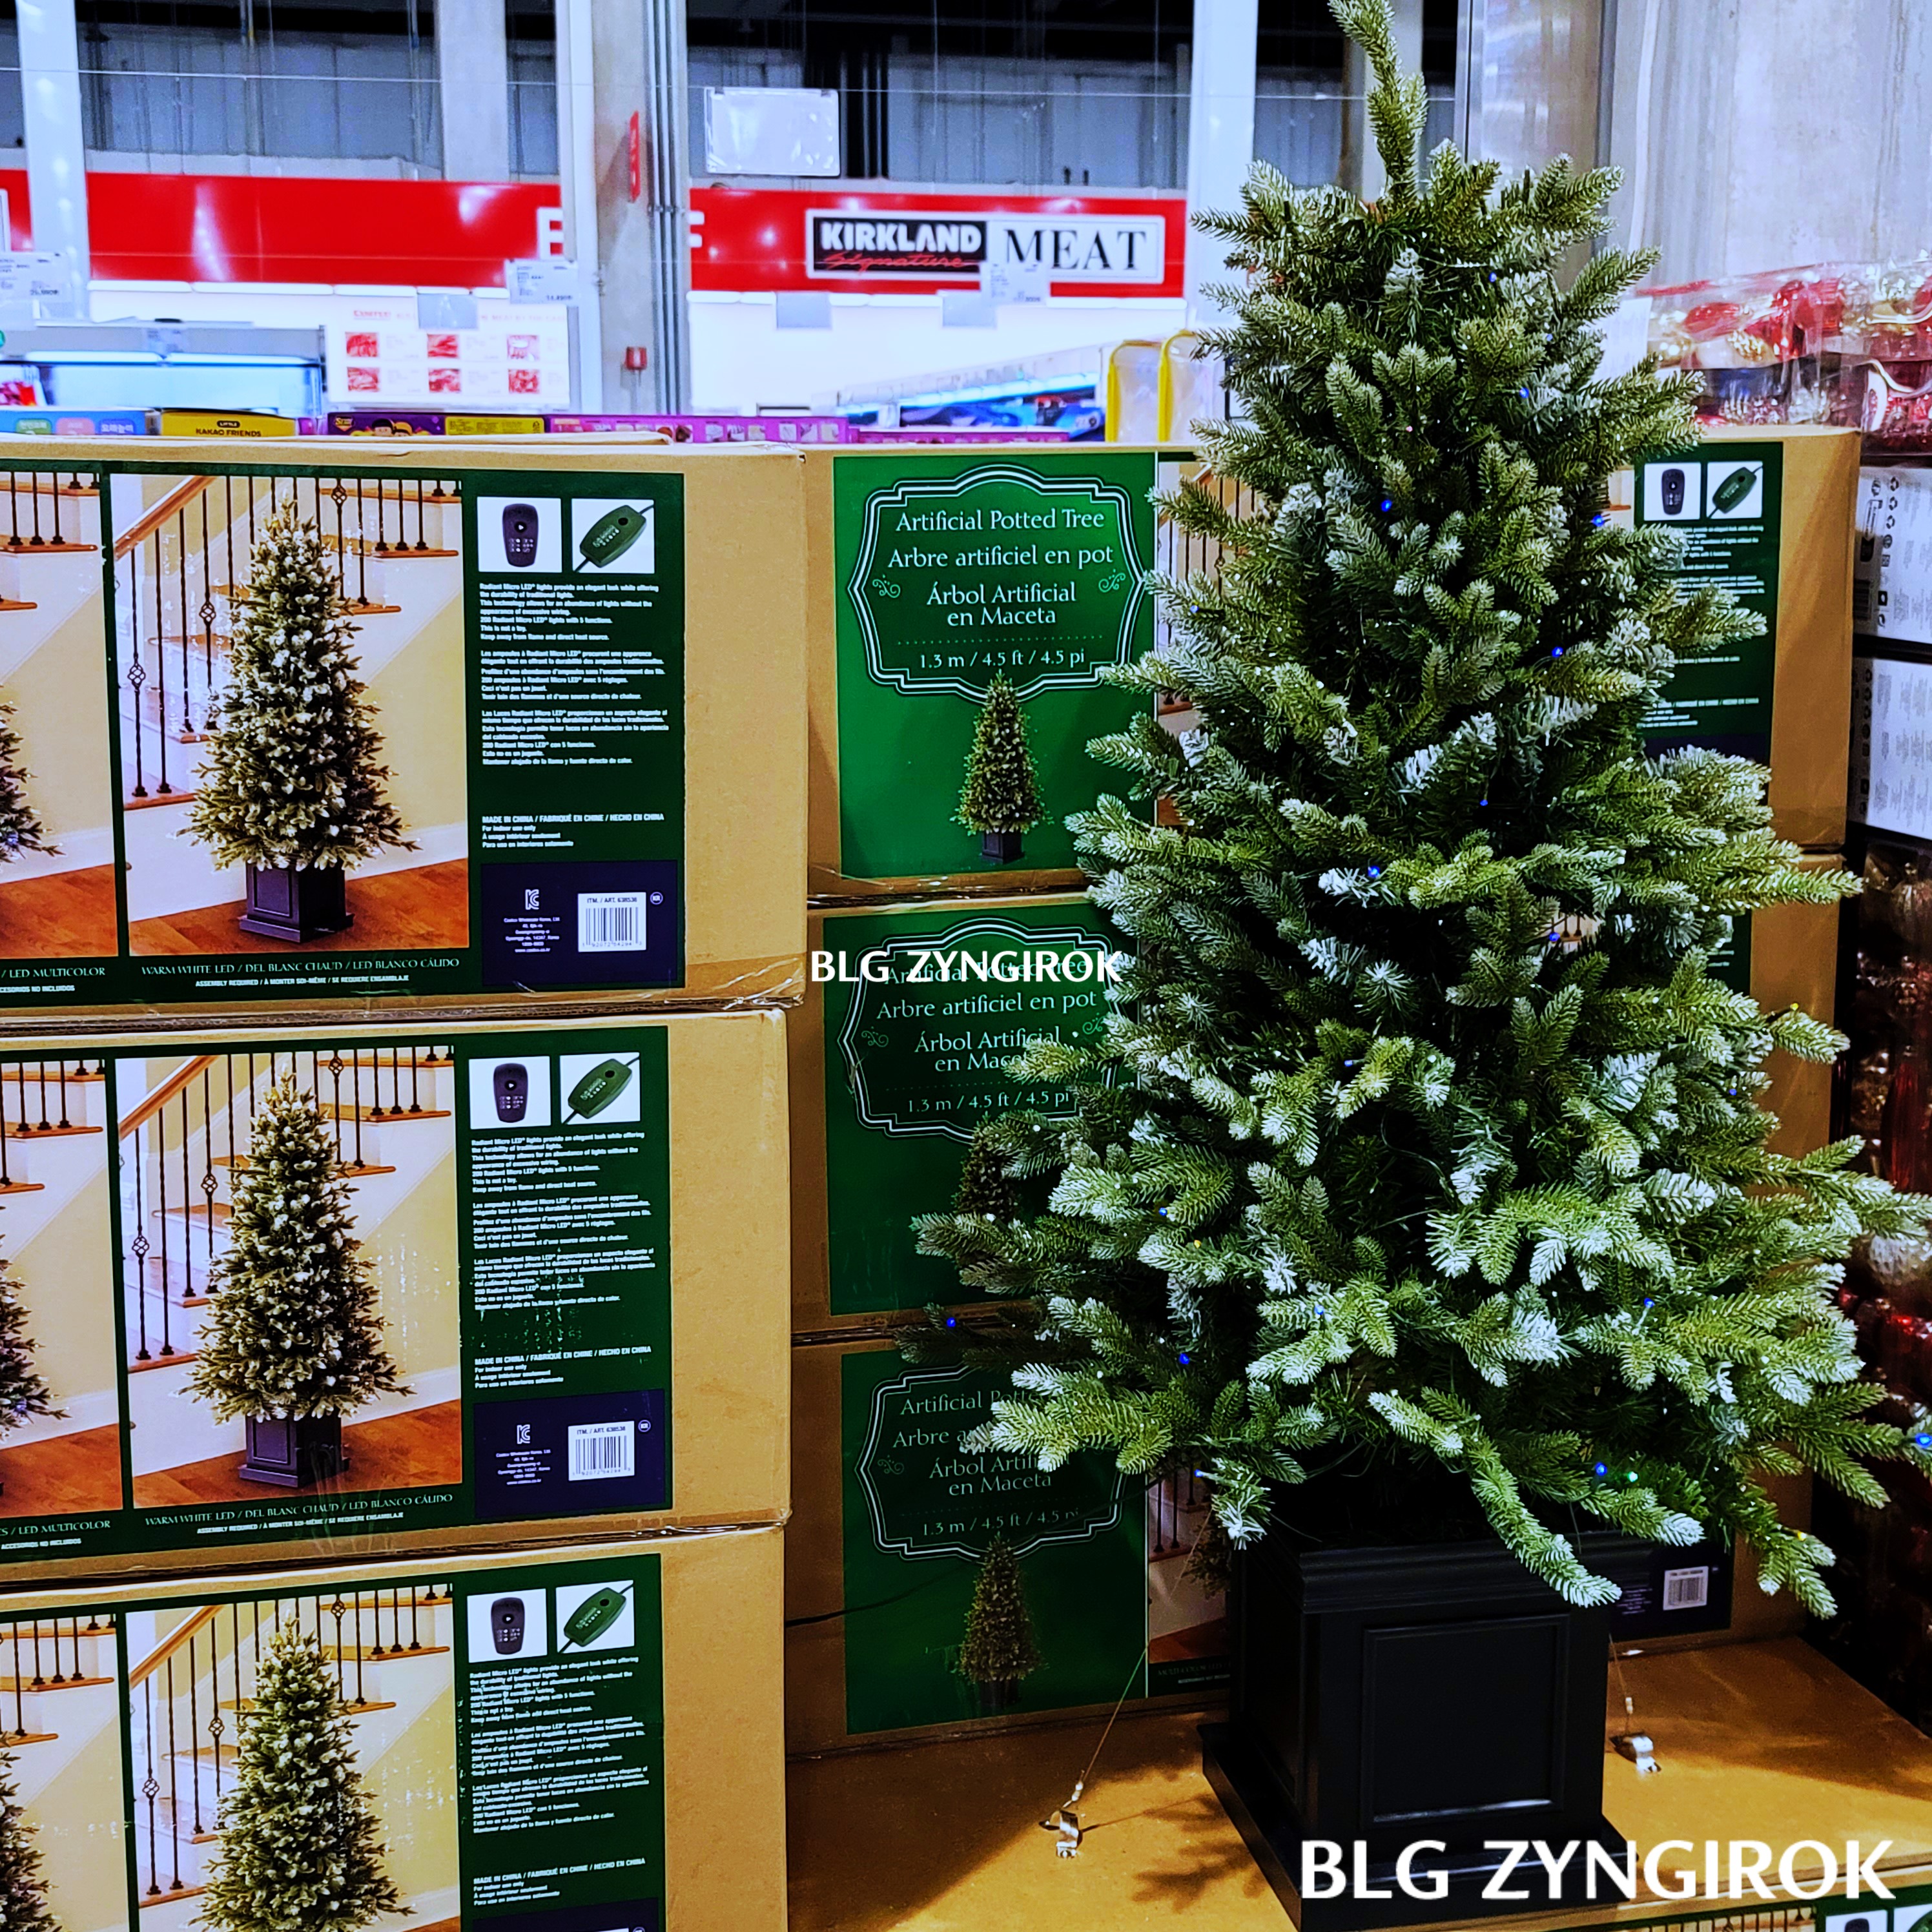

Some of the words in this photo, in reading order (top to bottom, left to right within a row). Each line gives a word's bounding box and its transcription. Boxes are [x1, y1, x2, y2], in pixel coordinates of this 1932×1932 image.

[821, 221, 982, 253] KIRKLAND
[1003, 228, 1147, 270] MEAT
[896, 509, 982, 531] Artificial
[991, 508, 1056, 529] Potted
[1062, 508, 1105, 528] Tree
[888, 548, 948, 568] Arbre
[956, 544, 1038, 566] artificiel
[1045, 550, 1070, 564] en
[1078, 546, 1113, 569] pot
[927, 582, 986, 605] Árbol
[991, 581, 1076, 603] Artificial
[947, 610, 973, 626] en
[980, 607, 1056, 625] Maceta
[920, 654, 942, 668] 1.3
[948, 656, 964, 667] m
[969, 651, 978, 666] /
[982, 652, 1005, 666] 4.5
[1011, 650, 1023, 666] ft
[1029, 650, 1037, 665] /
[1040, 650, 1064, 664] 4.5
[1069, 648, 1084, 668] pi
[10, 969, 30, 978] LED
[33, 967, 106, 978] MULTICOLOR
[141, 966, 176, 975] WARM
[178, 965, 212, 974] WHITE
[215, 964, 234, 973] LED
[245, 963, 266, 972] DEL
[269, 962, 302, 972] BLANC
[305, 961, 342, 971] CHAUD
[353, 961, 372, 969] LED
[376, 960, 418, 969] BLANCO
[420, 958, 459, 967] CÁLIDO
[876, 1000, 935, 1019] Arbre
[942, 992, 1022, 1015] artificiel
[1030, 995, 1054, 1009] en
[1063, 991, 1096, 1014] pot
[914, 1031, 972, 1053] Árbol
[935, 1058, 960, 1071] en
[908, 1099, 930, 1113] 1.3
[936, 1100, 951, 1110] m
[969, 1095, 992, 1108] 4.5
[998, 1092, 1009, 1106] ft
[1026, 1091, 1049, 1104] 4.5
[900, 1391, 982, 1415] Artificial
[892, 1428, 949, 1448] Arbre
[929, 1456, 985, 1478] Árbol
[949, 1483, 973, 1496] en
[980, 1475, 1051, 1493] Maceta
[145, 1516, 180, 1525] WARM
[180, 1513, 212, 1524] WHITE
[216, 1511, 235, 1521] LED
[245, 1508, 265, 1518] DEL
[268, 1506, 300, 1516] BLANC
[303, 1503, 339, 1514] CHAUD
[349, 1500, 368, 1510] LED
[371, 1497, 413, 1508] BLANCO
[415, 1494, 453, 1505] CÁLIDO
[19, 1526, 38, 1534] LED
[41, 1519, 110, 1533] MULTICOLOR
[923, 1522, 943, 1536] 1.3
[950, 1522, 965, 1532] m
[981, 1516, 1004, 1528] 4.5
[1011, 1513, 1021, 1526] ft
[1038, 1510, 1060, 1524] 4.5
